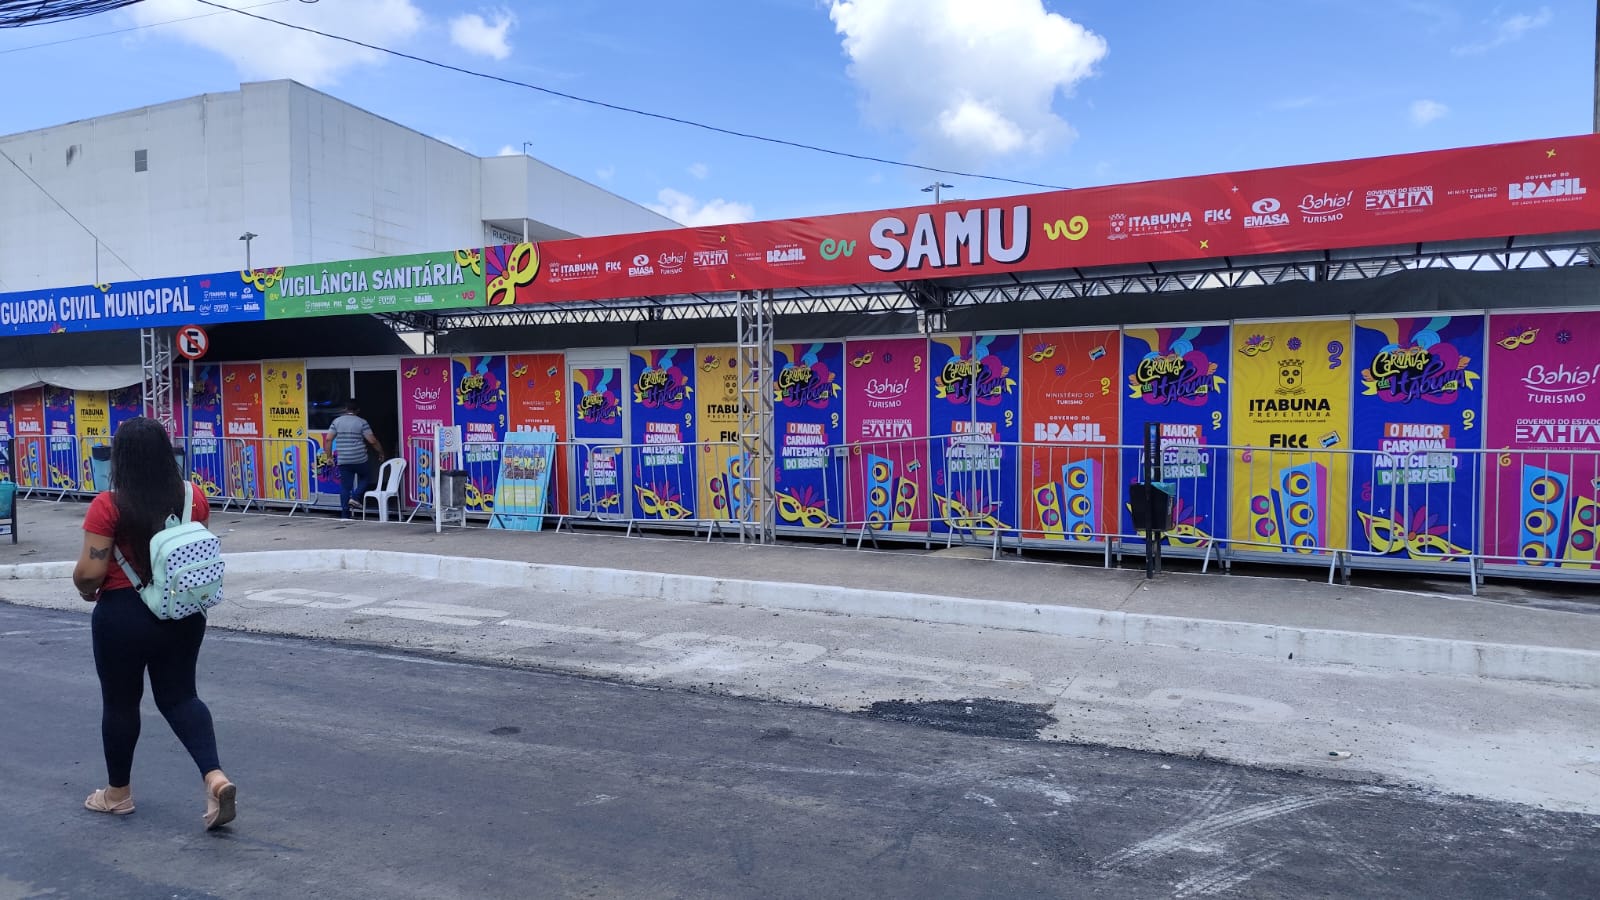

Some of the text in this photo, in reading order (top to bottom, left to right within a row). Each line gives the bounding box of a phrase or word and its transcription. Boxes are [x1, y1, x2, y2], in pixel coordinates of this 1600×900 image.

[1508, 178, 1586, 200] BRASIL
[1297, 190, 1353, 210] Bahia!
[1366, 191, 1433, 210] BAHIA
[1129, 211, 1192, 227] ITABUNA
[1204, 208, 1232, 222] FICC
[1244, 213, 1289, 228] EMASA
[1303, 212, 1343, 223] TURISMO
[868, 205, 1030, 272] SAMU
[657, 252, 687, 265] Bahia!
[693, 252, 728, 266] BAHIA
[766, 248, 806, 263] BRASIL
[560, 262, 599, 274] ITABUNA
[629, 266, 654, 277] EMASA
[279, 260, 464, 298] VIGILÂNCIA SANITÁRIA
[1, 298, 56, 325] GUARDA
[60, 294, 100, 321] CIVIL
[104, 285, 195, 317] MUNICIPAL
[186, 330, 199, 354] E
[1521, 363, 1600, 384] Bahia!
[864, 378, 909, 394] Bahia!
[412, 387, 441, 400] Bahia!
[1528, 393, 1586, 403] TURISMO
[269, 407, 299, 415] ITABUNA
[868, 400, 901, 409] TURISMO
[1249, 398, 1330, 411] ITABUNA
[228, 422, 258, 435] BRASIL
[655, 423, 676, 434] MAIOR
[790, 423, 821, 434] O MAIOR
[862, 423, 912, 437] BAHIA
[955, 422, 962, 433] O
[1034, 422, 1106, 442] BRASIL
[1163, 424, 1197, 437] MAIOR
[1390, 423, 1444, 438] O MAIOR
[1516, 424, 1600, 443] BAHIA
[646, 433, 680, 444] CARNAVAL
[786, 435, 825, 446] CARNAVAL
[1269, 433, 1309, 448] FICC
[1383, 439, 1447, 453] CARNAVAL
[786, 458, 796, 470] DO
[1164, 464, 1205, 478] BRASIL
